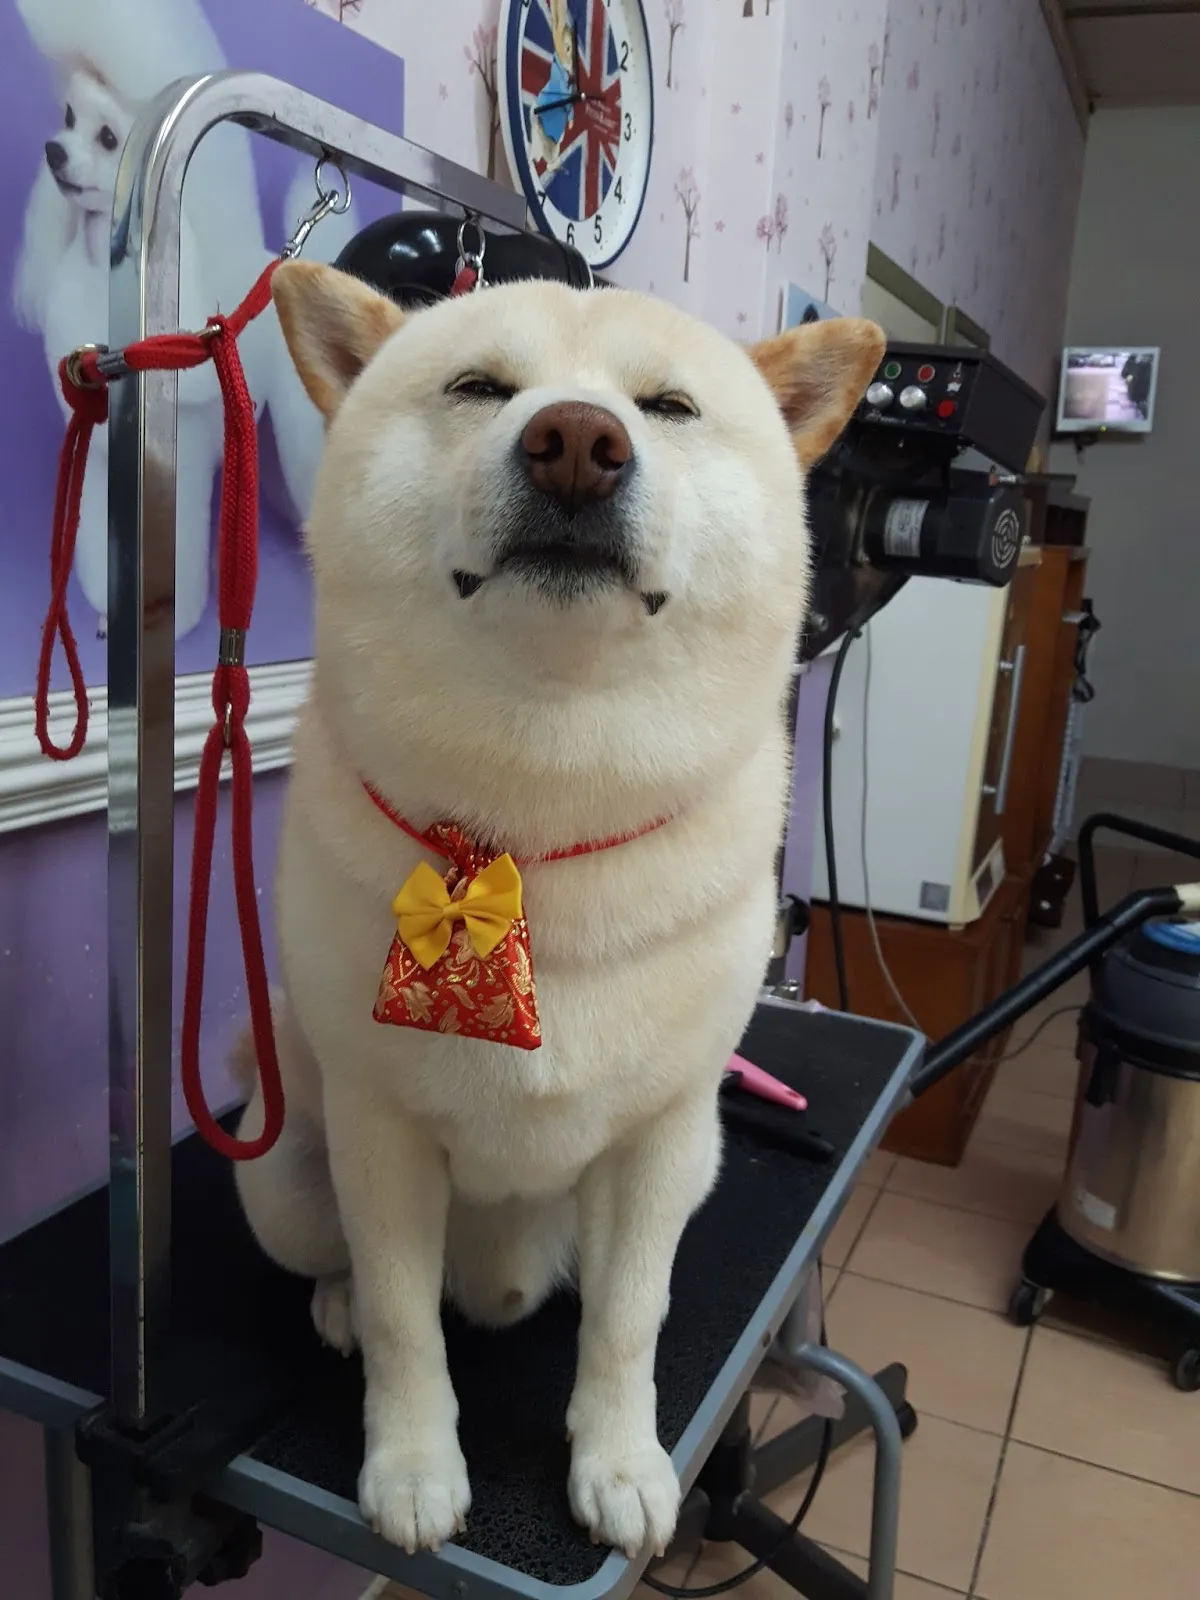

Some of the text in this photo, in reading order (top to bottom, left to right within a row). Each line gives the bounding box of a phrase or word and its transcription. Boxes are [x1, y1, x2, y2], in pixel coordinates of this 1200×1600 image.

[620, 40, 629, 72] 2
[624, 112, 632, 142] 3
[614, 175, 622, 204] 4
[566, 222, 575, 246] 6
[594, 214, 602, 244] 5
